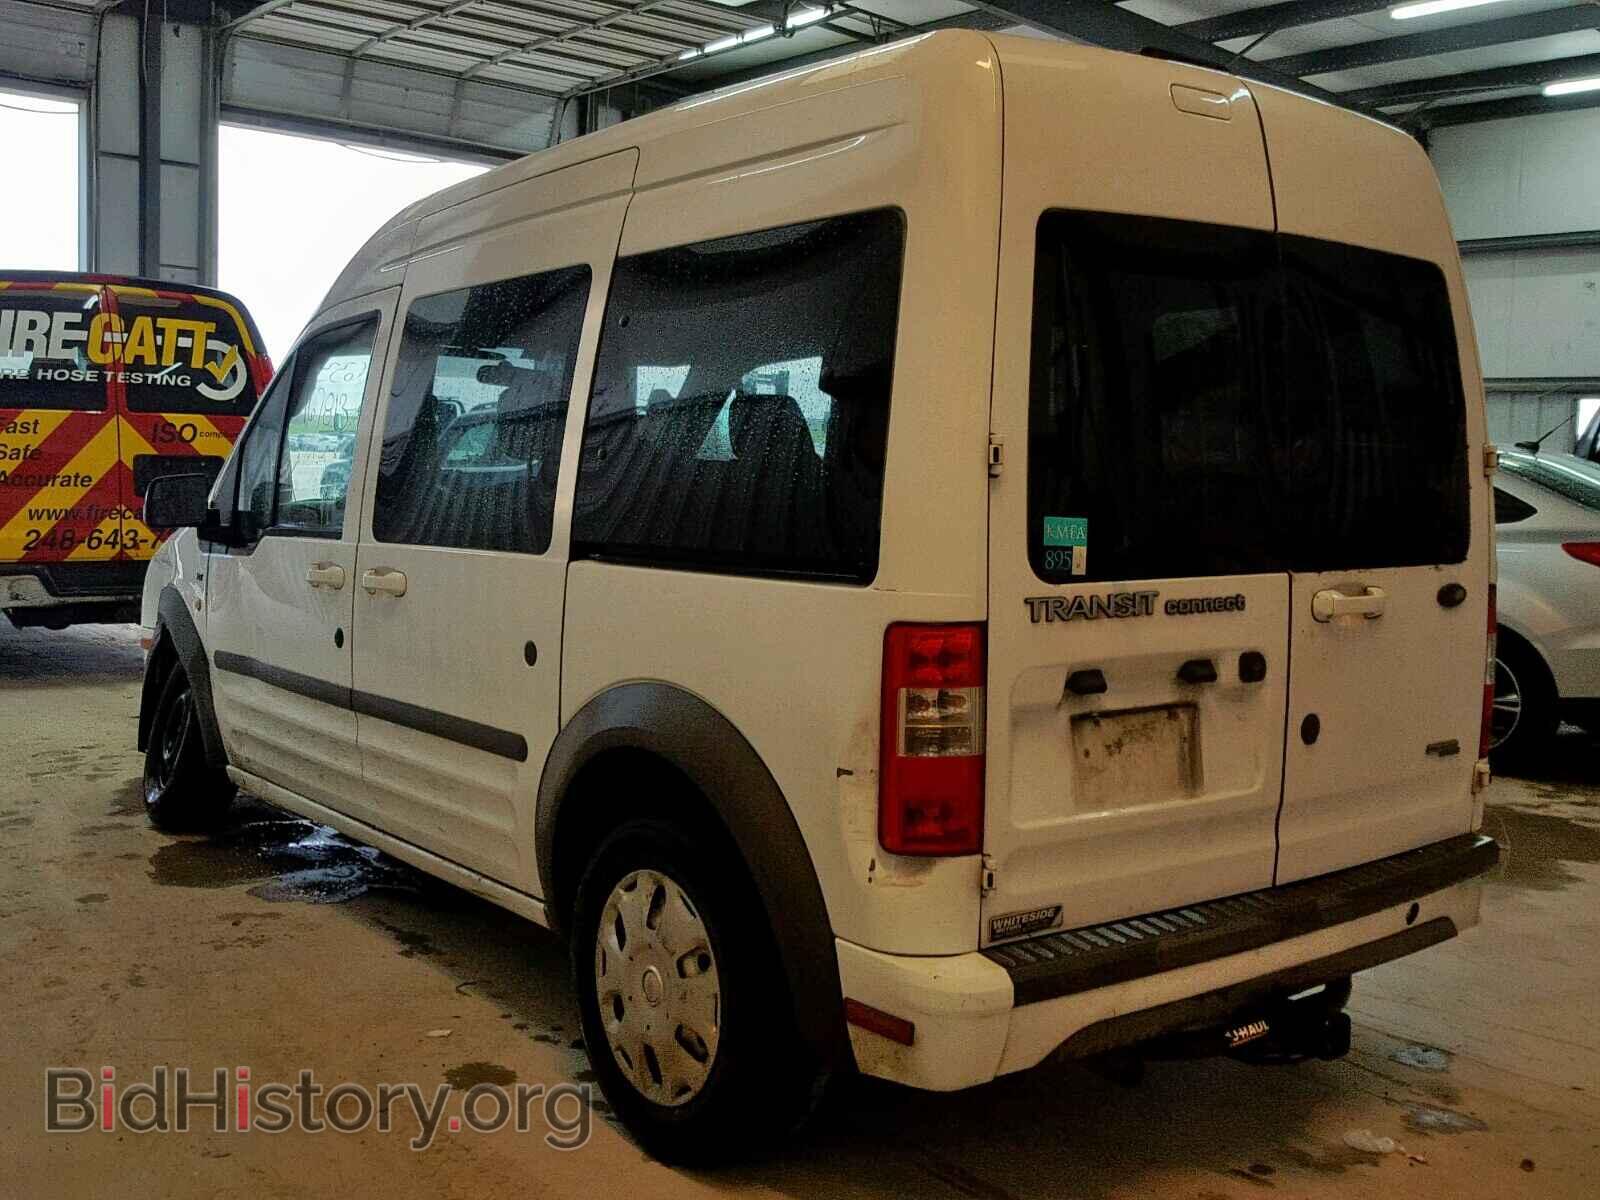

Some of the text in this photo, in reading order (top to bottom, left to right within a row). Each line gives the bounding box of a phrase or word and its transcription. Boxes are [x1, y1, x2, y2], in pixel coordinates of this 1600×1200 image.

[0, 367, 192, 387] RE HOSE TESTING
[151, 422, 198, 444] ISO
[0, 443, 42, 461] Safe
[0, 470, 93, 488] Accurate
[27, 502, 146, 521] www.fireca
[22, 528, 164, 551] 248-643-7
[1024, 591, 1247, 623] TRANSIT connect
[992, 907, 1057, 930] WHITESIDE
